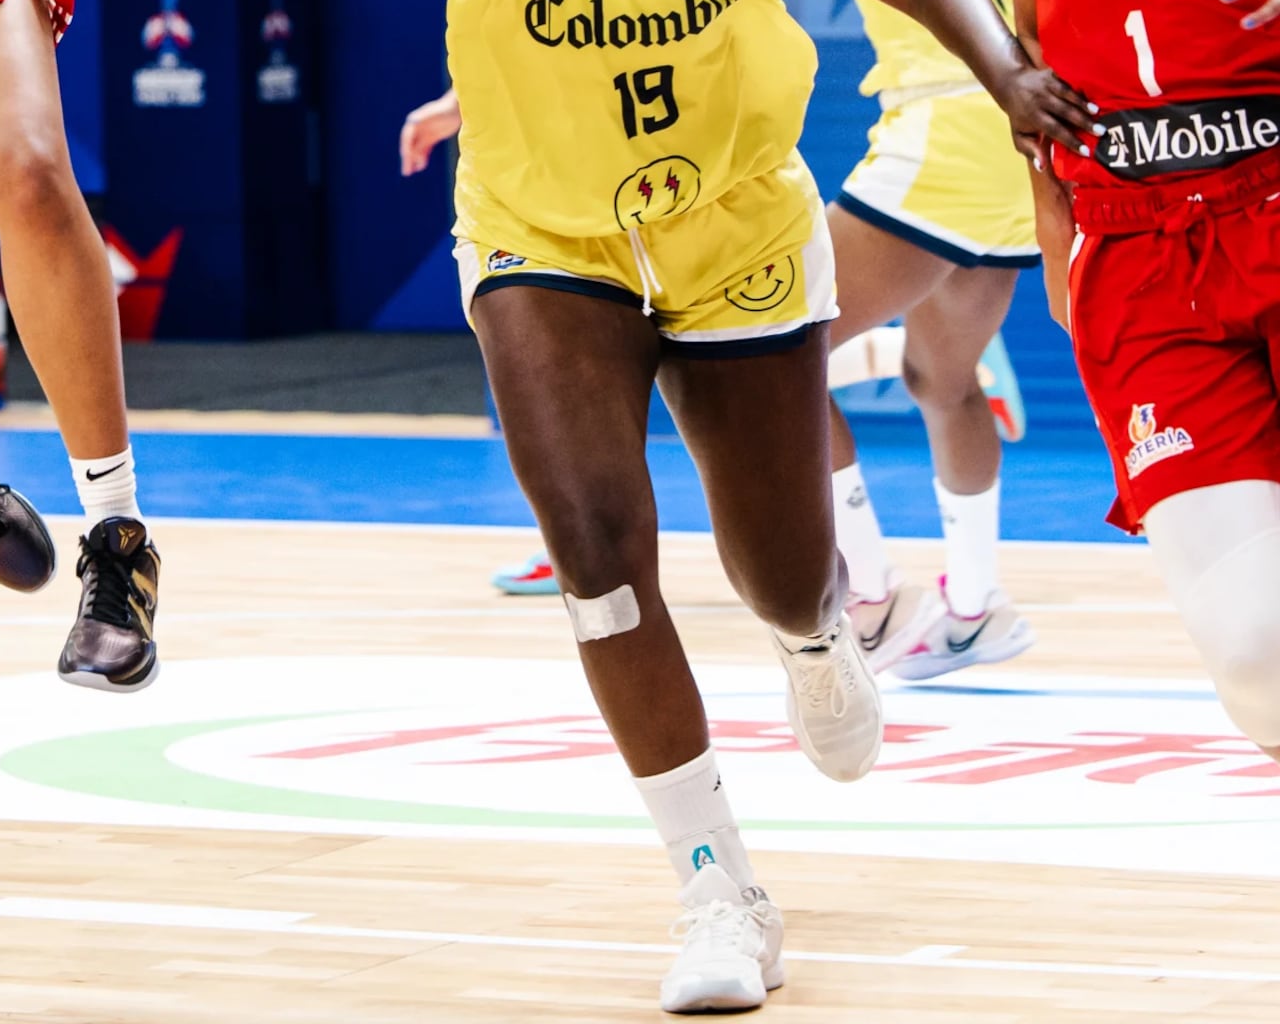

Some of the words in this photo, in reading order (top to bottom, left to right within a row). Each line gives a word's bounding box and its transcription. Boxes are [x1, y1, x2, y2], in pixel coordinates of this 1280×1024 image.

[1124, 9, 1163, 97] 1
[613, 64, 680, 140] 19
[1128, 109, 1280, 166] Mobile
